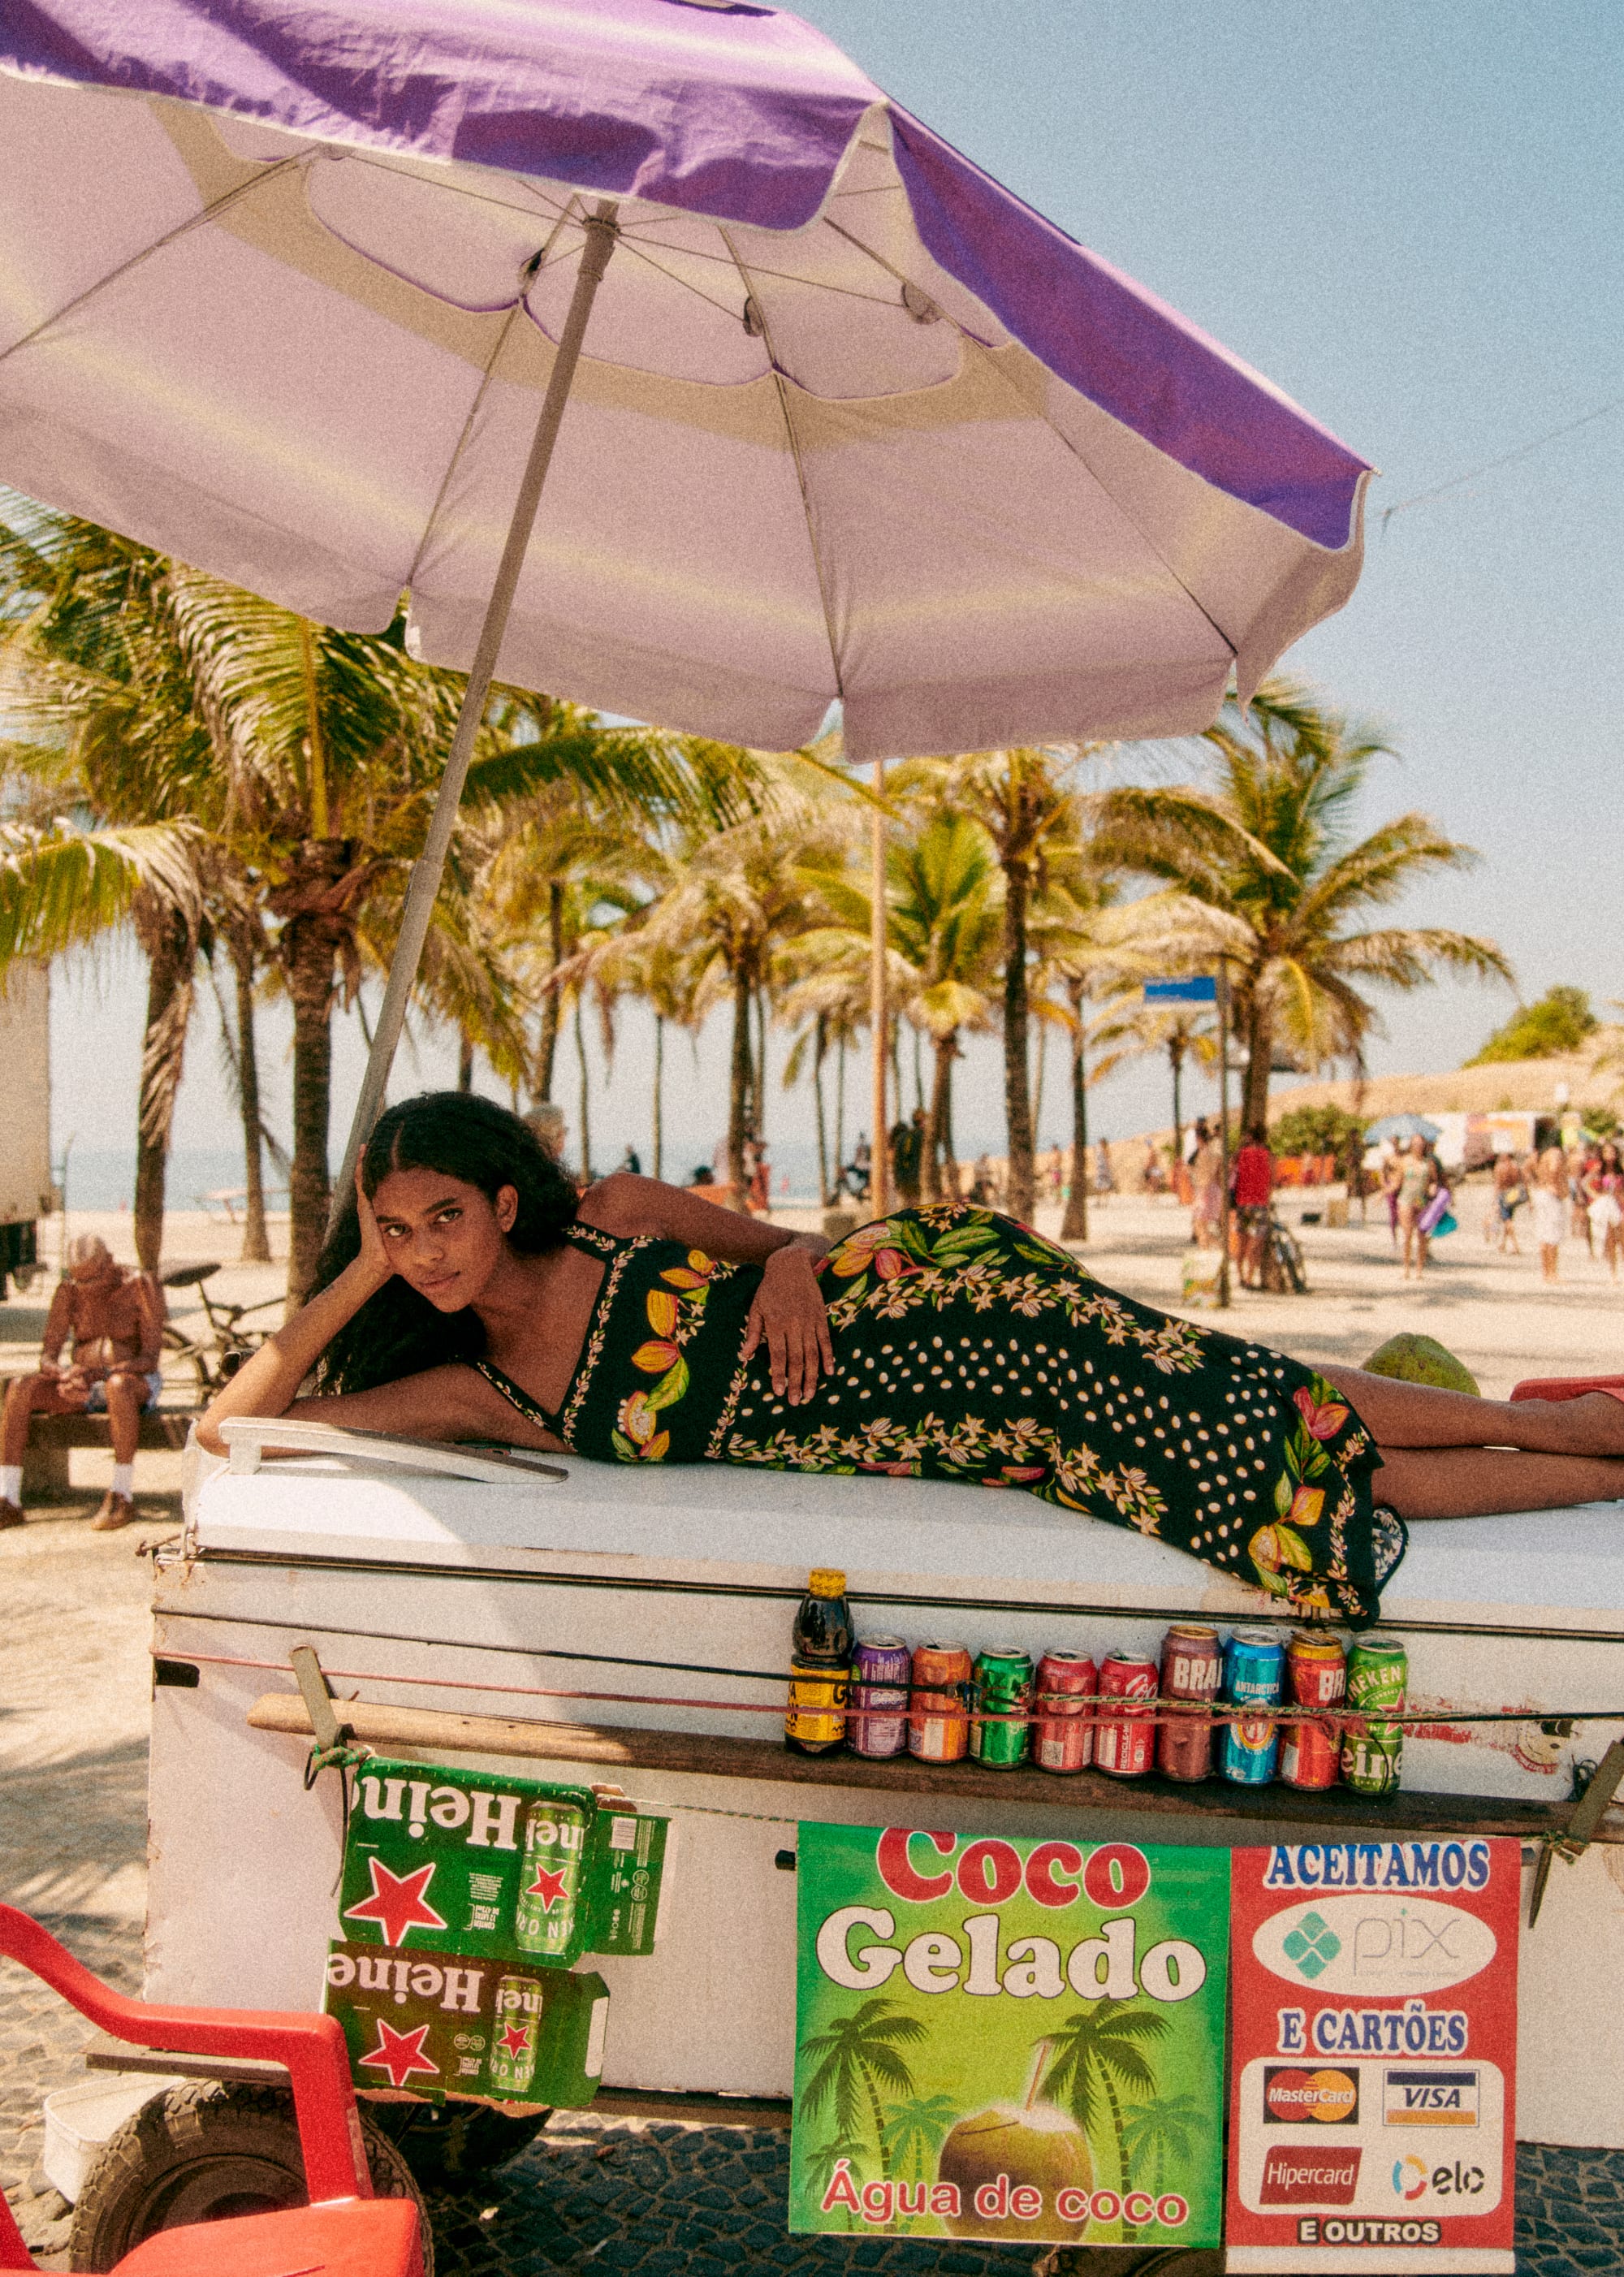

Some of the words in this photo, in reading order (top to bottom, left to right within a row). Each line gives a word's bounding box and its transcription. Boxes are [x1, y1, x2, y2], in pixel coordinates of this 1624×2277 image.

[1235, 1680, 1279, 1694] ANTARCTICA
[1319, 1669, 1345, 1700] BR
[1120, 1722, 1130, 1769] RECICLE-M
[351, 1776, 521, 1851] Hein
[877, 1827, 1151, 1908] Coco
[1266, 1842, 1489, 1886] ACEITAMOS
[817, 1905, 1207, 2002] Gelado
[1354, 1908, 1460, 1977] pix
[327, 1952, 485, 2013] Heine
[1281, 2012, 1301, 2050] E
[1317, 2003, 1466, 2051] CARTÕES
[1268, 2088, 1354, 2106] MasterCard
[1404, 2088, 1461, 2109] VISA
[821, 2158, 961, 2224] Água
[975, 2174, 1042, 2221] de
[1057, 2188, 1188, 2226] coco
[1268, 2162, 1355, 2188] Hipercard
[1432, 2161, 1484, 2194] elo
[1301, 2220, 1320, 2242] E
[1325, 2220, 1440, 2242] OUTROS
